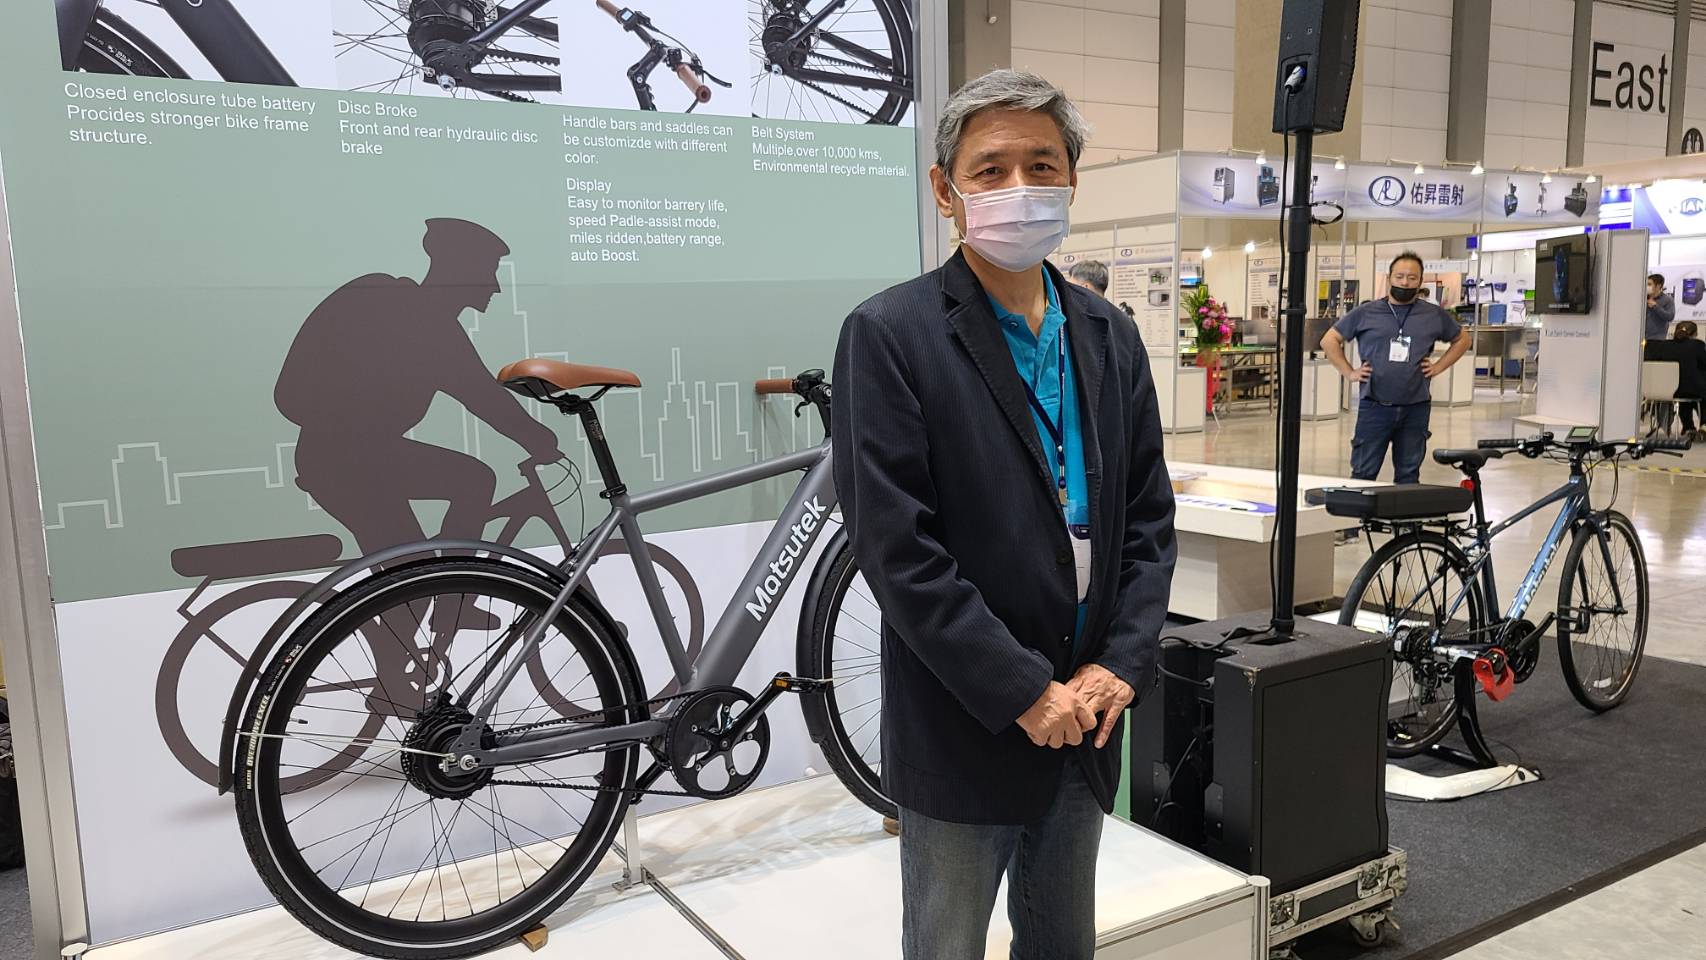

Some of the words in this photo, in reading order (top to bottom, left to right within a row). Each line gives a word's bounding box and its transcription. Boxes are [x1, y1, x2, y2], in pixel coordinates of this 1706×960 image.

[1590, 41, 1668, 114] East
[64, 82, 127, 101] Closed
[132, 88, 216, 106] enclosure
[220, 92, 257, 109] tube
[261, 95, 316, 115] battery
[66, 104, 146, 122] Procides
[150, 110, 221, 129] stronger
[225, 113, 259, 130] bike
[262, 115, 309, 132] frame
[337, 99, 371, 115] Disc
[375, 101, 418, 118] Broke
[339, 119, 380, 136] Front
[382, 122, 410, 137] and
[414, 126, 443, 138] rear
[446, 125, 508, 143] hydraulic
[511, 129, 539, 144] disc
[562, 113, 607, 129] Handle
[609, 116, 637, 131] bars
[639, 119, 663, 132] and
[665, 121, 711, 135] saddles
[712, 125, 734, 137] can
[751, 125, 773, 139] Belt
[775, 127, 815, 143] System
[69, 127, 153, 145] structure.
[563, 132, 580, 146] be
[583, 135, 652, 149] customizde
[654, 137, 679, 151] with
[681, 139, 729, 153] different
[341, 139, 384, 155] brake
[822, 145, 857, 160] 10,000
[753, 158, 828, 174] Environmental
[830, 163, 866, 177] recycle
[868, 164, 910, 177] material.
[566, 177, 612, 195] Display
[1410, 182, 1464, 206] 佑昇雷射
[567, 194, 599, 212] Easy
[601, 196, 614, 209] to
[616, 197, 662, 210] monitor
[664, 198, 706, 214] barrery
[708, 199, 729, 213] life,
[568, 215, 607, 229] speed
[609, 213, 683, 228] Padle-assist
[684, 216, 721, 230] mode,
[569, 232, 603, 245] miles
[570, 249, 599, 262] auto
[601, 248, 640, 262] Boost.
[745, 495, 827, 622] Matsutek
